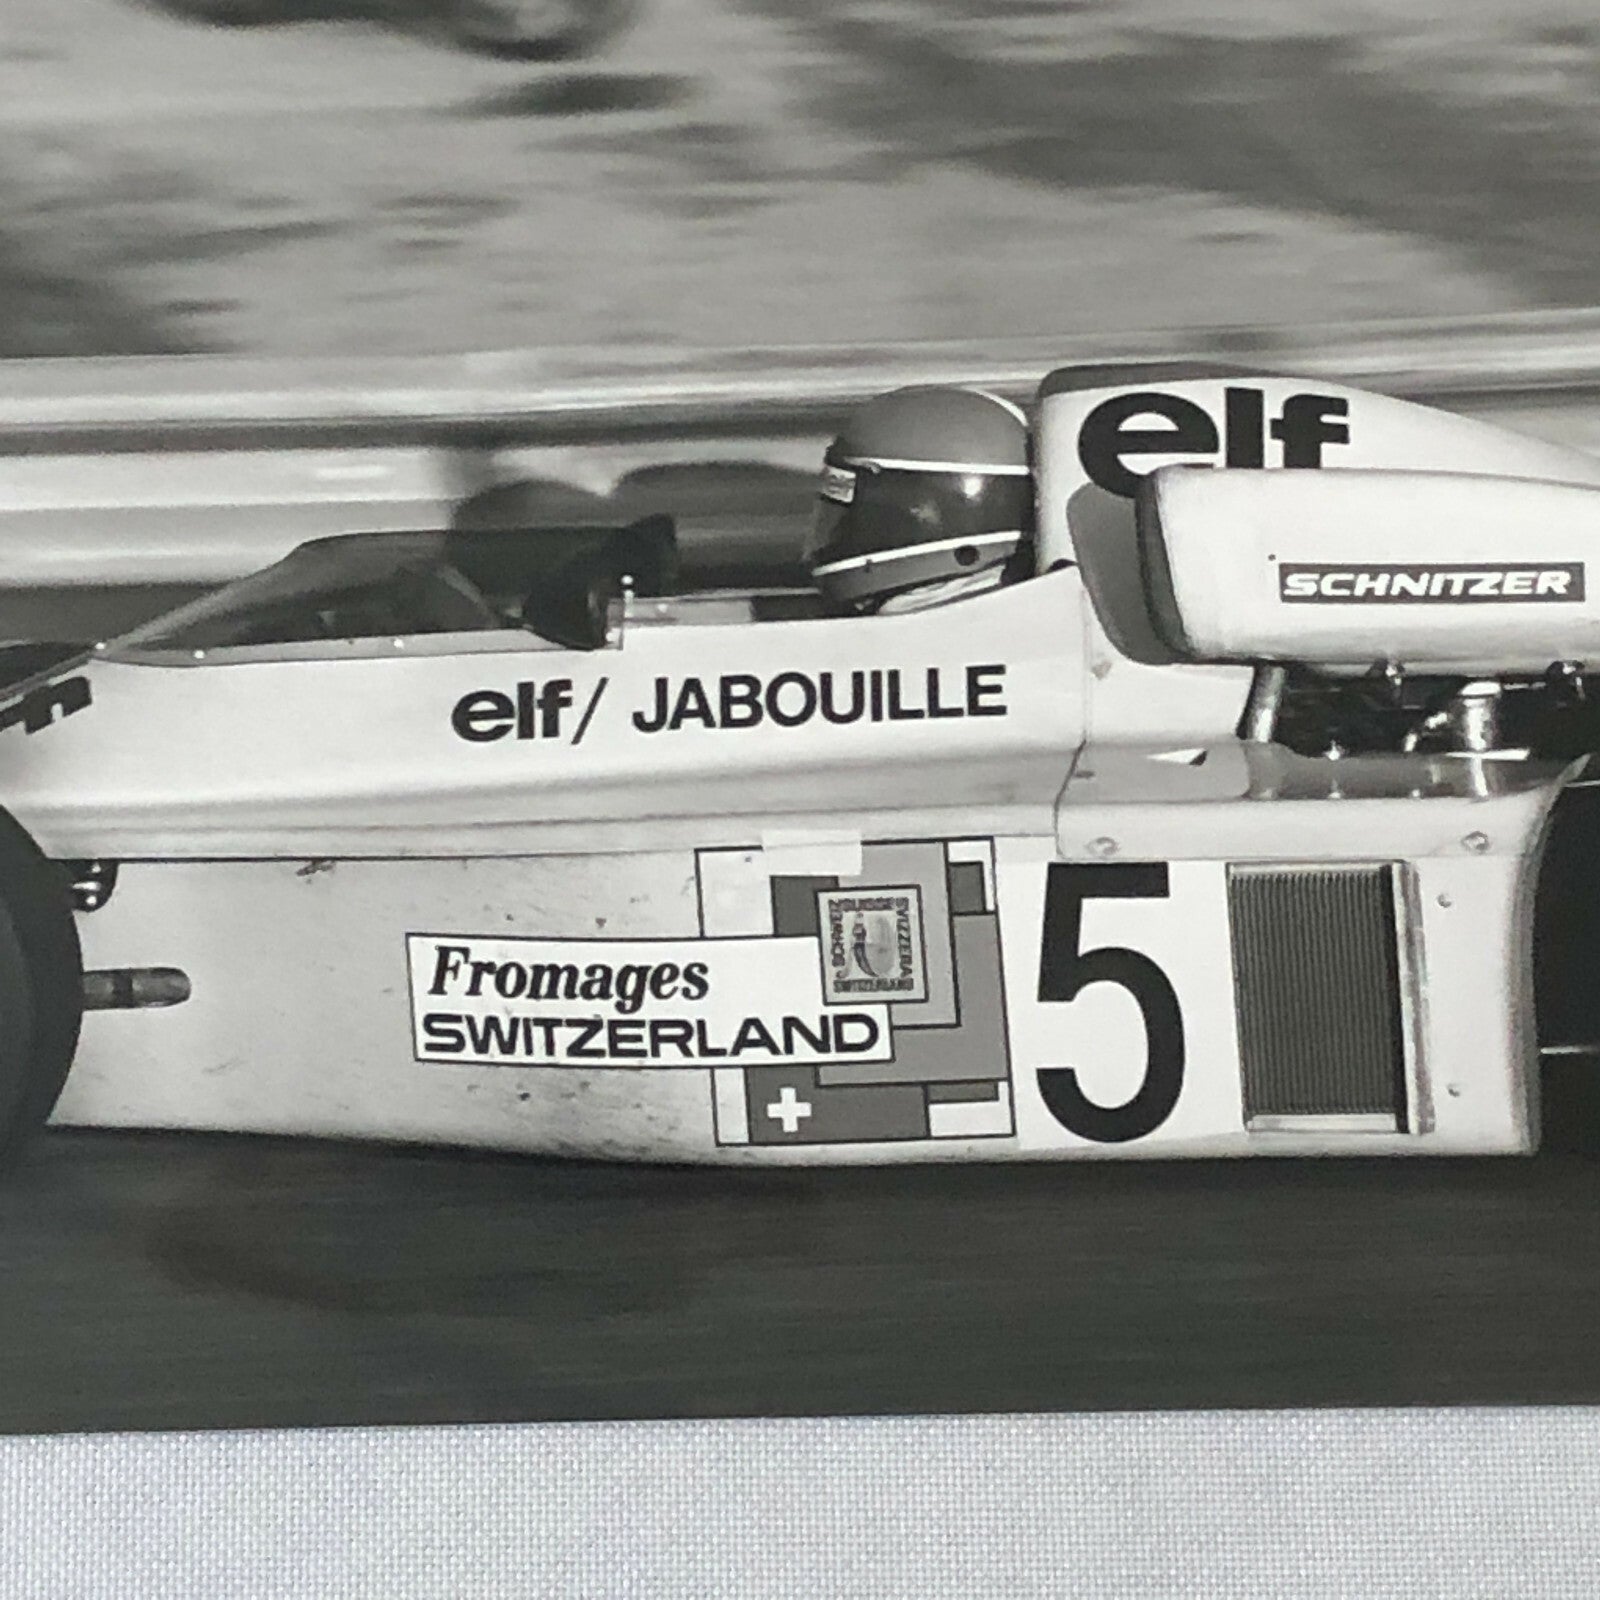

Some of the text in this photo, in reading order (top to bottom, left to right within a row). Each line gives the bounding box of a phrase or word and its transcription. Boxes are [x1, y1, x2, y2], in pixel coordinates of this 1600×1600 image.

[1078, 387, 1351, 499] elf
[1282, 570, 1573, 598] SCHNITZER
[633, 664, 1008, 733] JABOUILLE
[427, 945, 710, 1014] Fromages
[1036, 861, 1187, 1143] 5
[423, 1013, 880, 1058] SWITZERLAND
